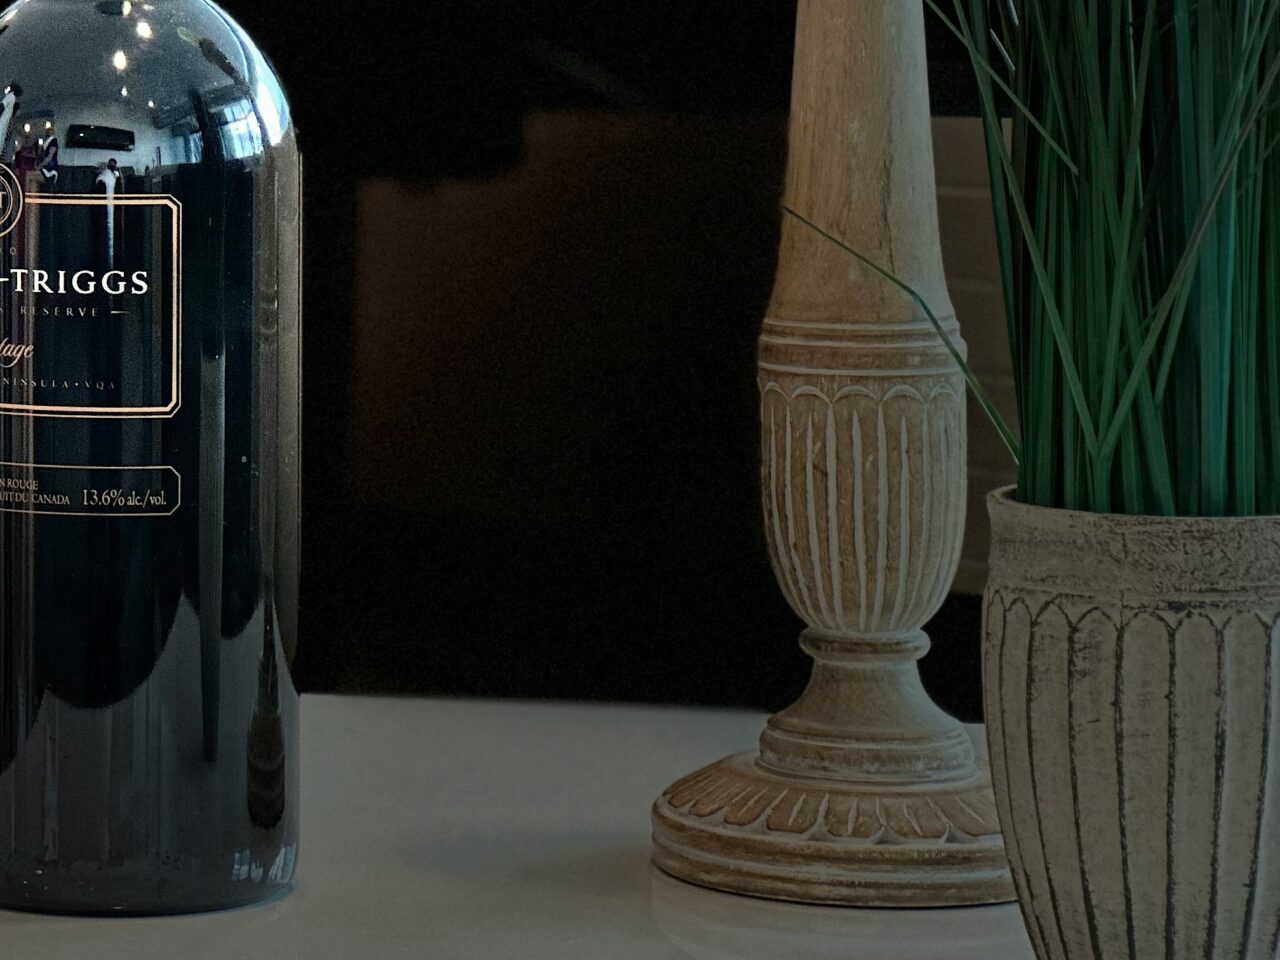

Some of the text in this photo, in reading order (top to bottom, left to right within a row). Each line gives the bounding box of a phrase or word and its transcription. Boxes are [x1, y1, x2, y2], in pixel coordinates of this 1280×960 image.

[20, 305, 99, 318] RESERVE
[6, 477, 39, 491] ROUGE
[31, 492, 71, 506] CANADA
[82, 489, 125, 507] 13.6%
